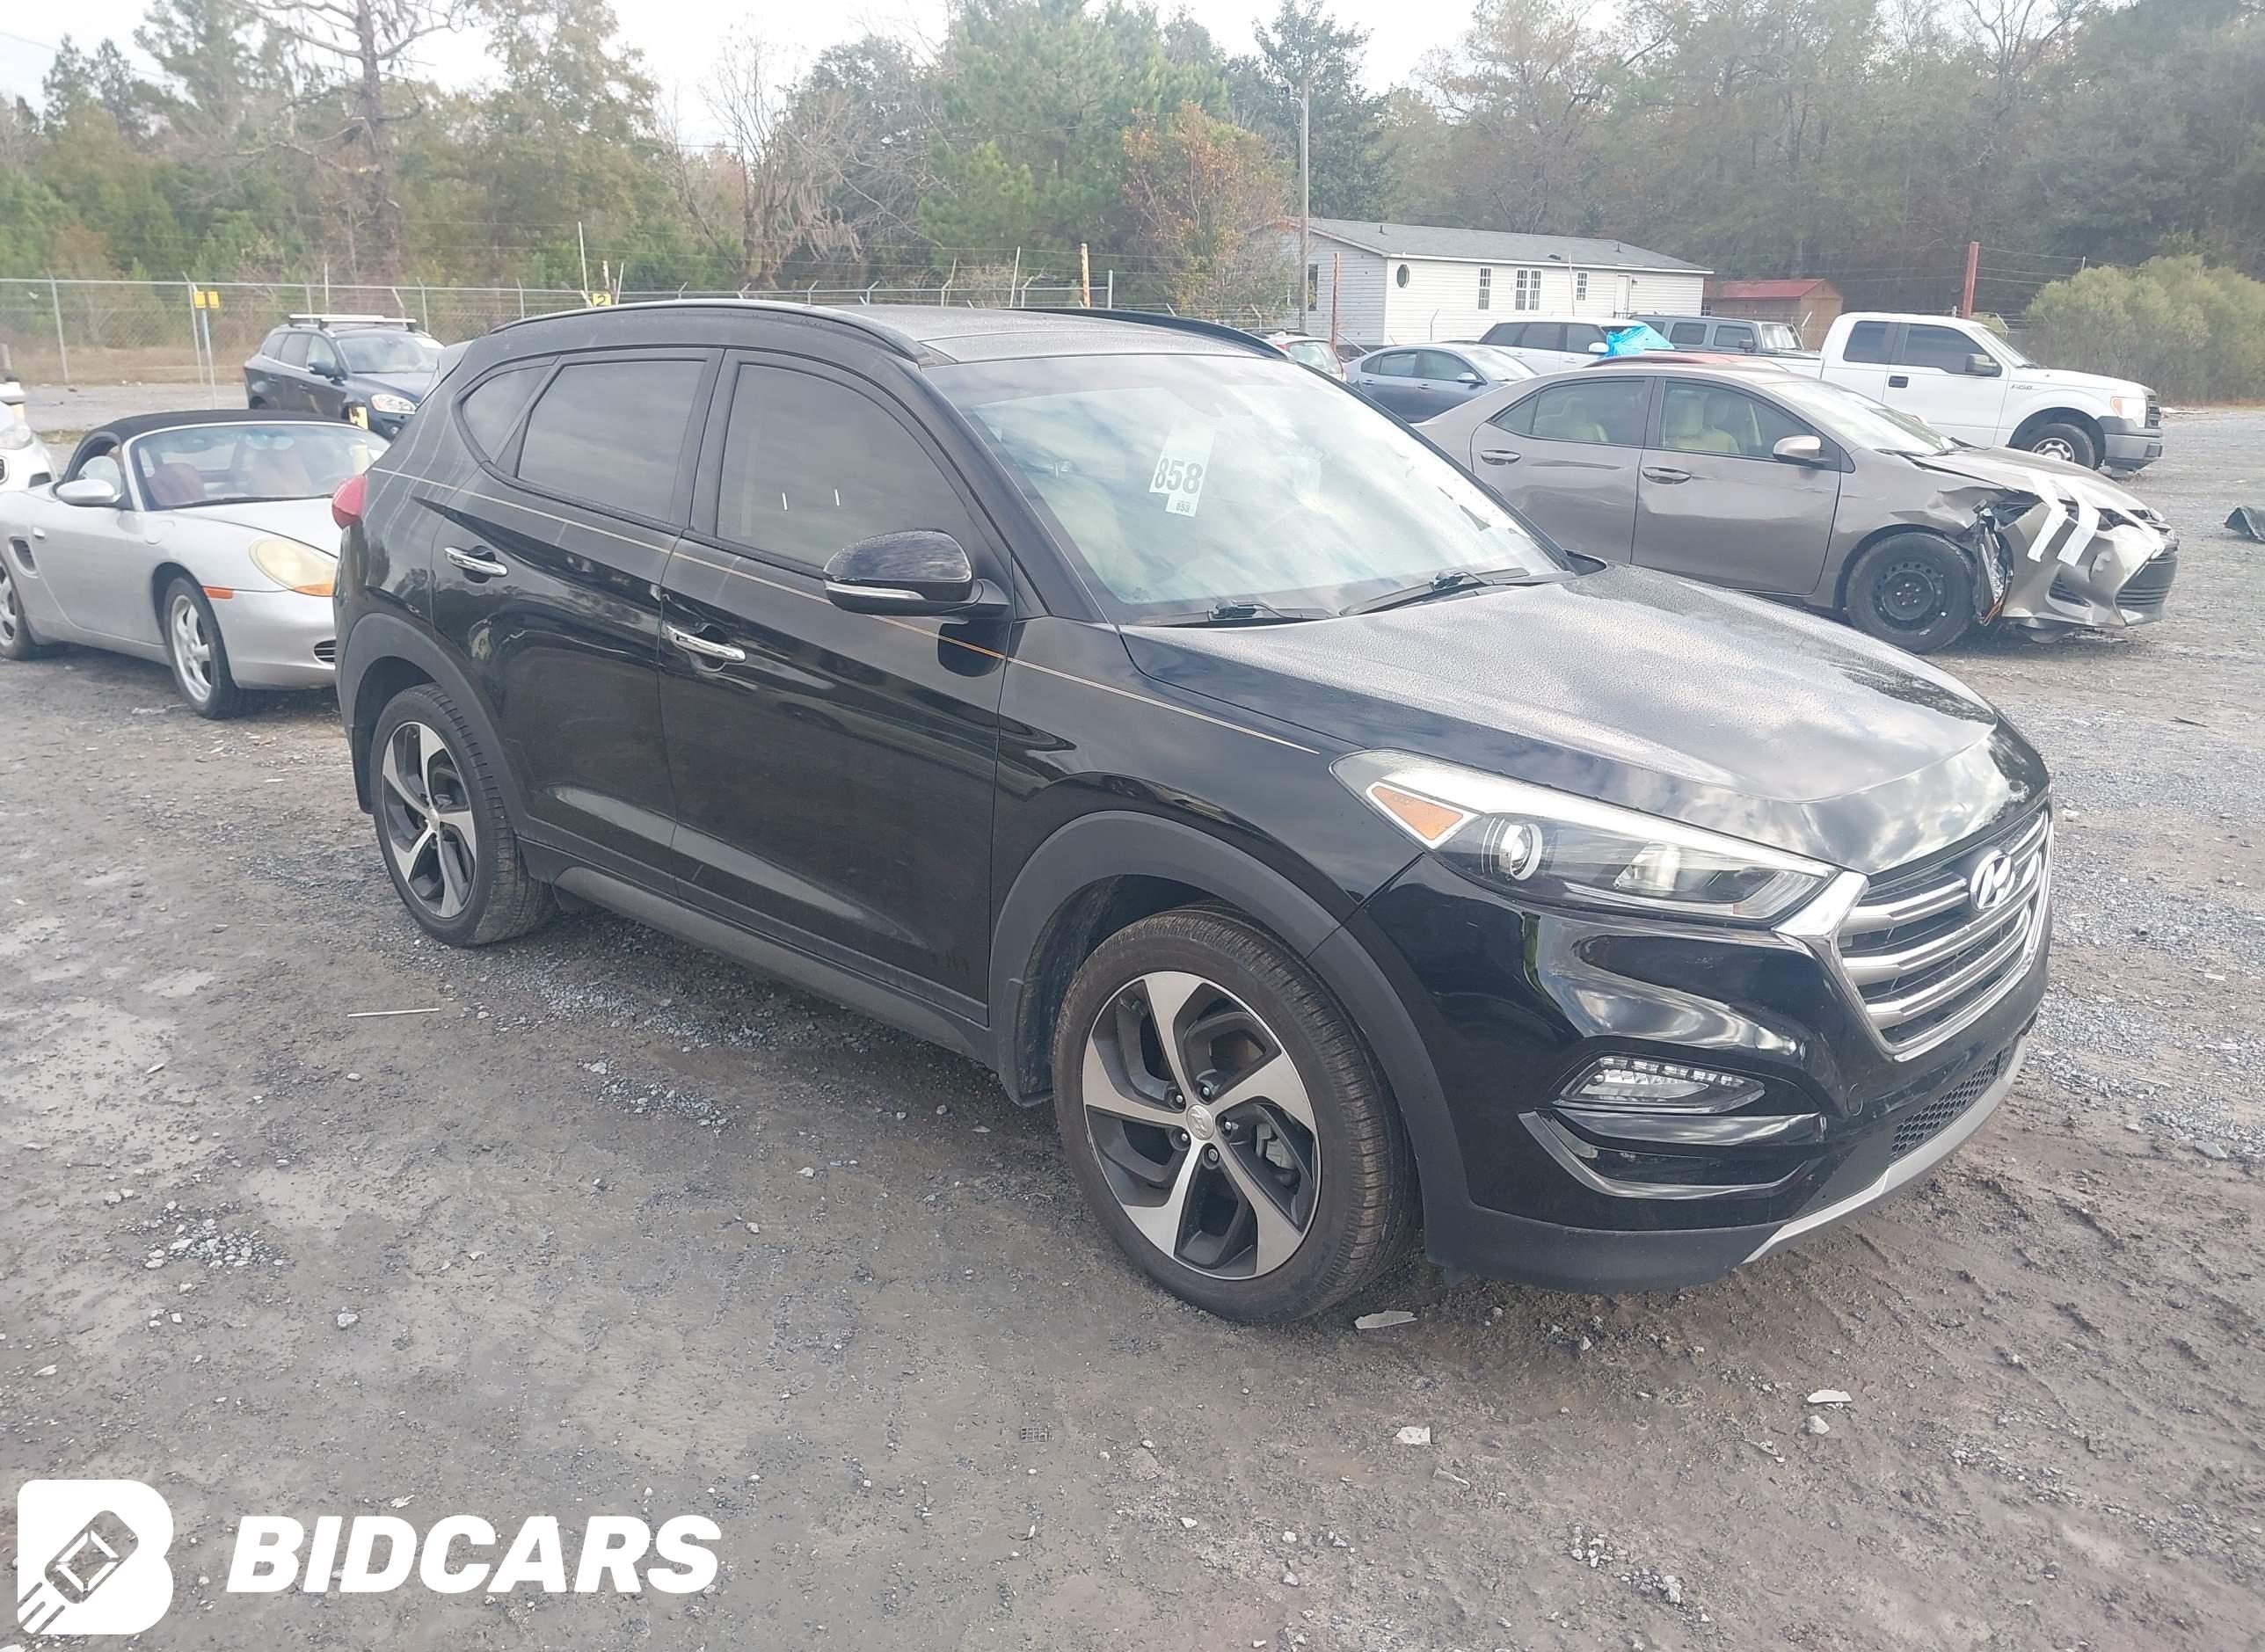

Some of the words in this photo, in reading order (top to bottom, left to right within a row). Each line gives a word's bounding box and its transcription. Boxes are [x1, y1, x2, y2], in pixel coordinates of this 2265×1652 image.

[596, 295, 607, 307] 2
[1154, 458, 1203, 494] 858
[1176, 502, 1191, 513] 858
